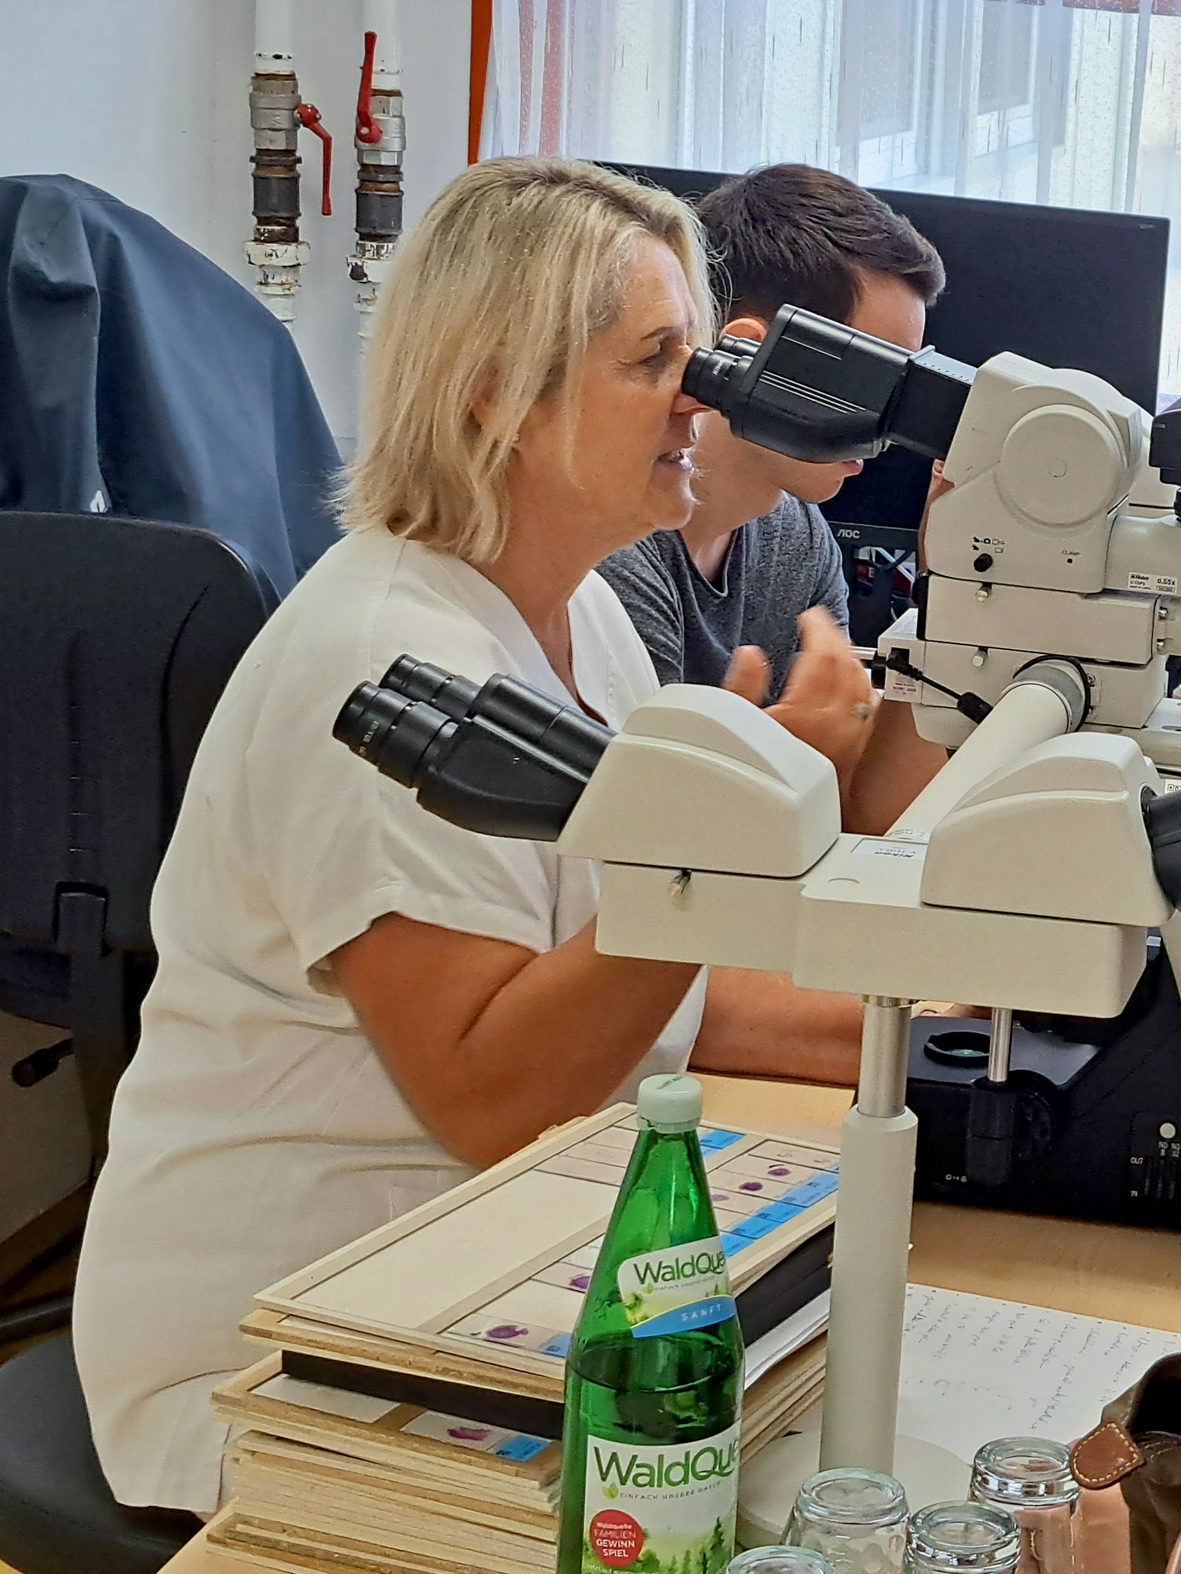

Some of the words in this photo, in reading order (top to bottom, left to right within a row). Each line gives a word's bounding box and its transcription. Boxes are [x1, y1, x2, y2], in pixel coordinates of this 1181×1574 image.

[837, 528, 860, 539] AOC
[1130, 1156, 1144, 1165] OUT
[681, 1303, 722, 1321] SANFT
[594, 1529, 636, 1539] FAMILIEN
[596, 1538, 636, 1549] GEWINN
[602, 1548, 629, 1558] SPIEL
